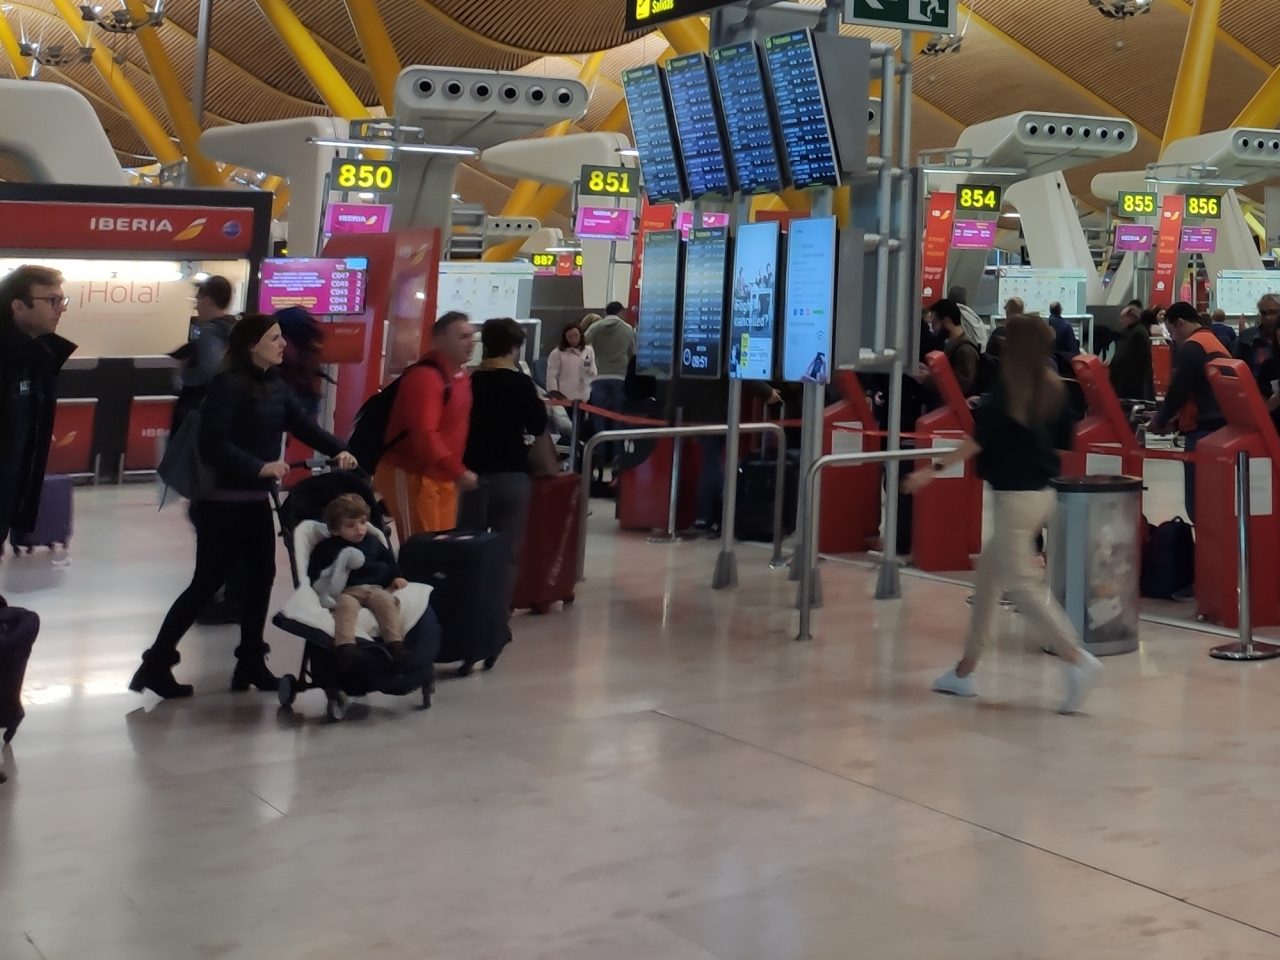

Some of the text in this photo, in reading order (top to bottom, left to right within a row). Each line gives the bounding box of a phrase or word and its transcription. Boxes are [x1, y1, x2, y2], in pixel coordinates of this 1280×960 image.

[338, 164, 393, 189] 850
[588, 170, 630, 193] 851
[960, 188, 996, 208] 854
[1123, 195, 1153, 212] 855
[1188, 197, 1217, 215] 856
[90, 217, 173, 232] IBERIA
[533, 254, 554, 266] 887
[79, 281, 161, 309] ¡Hola!
